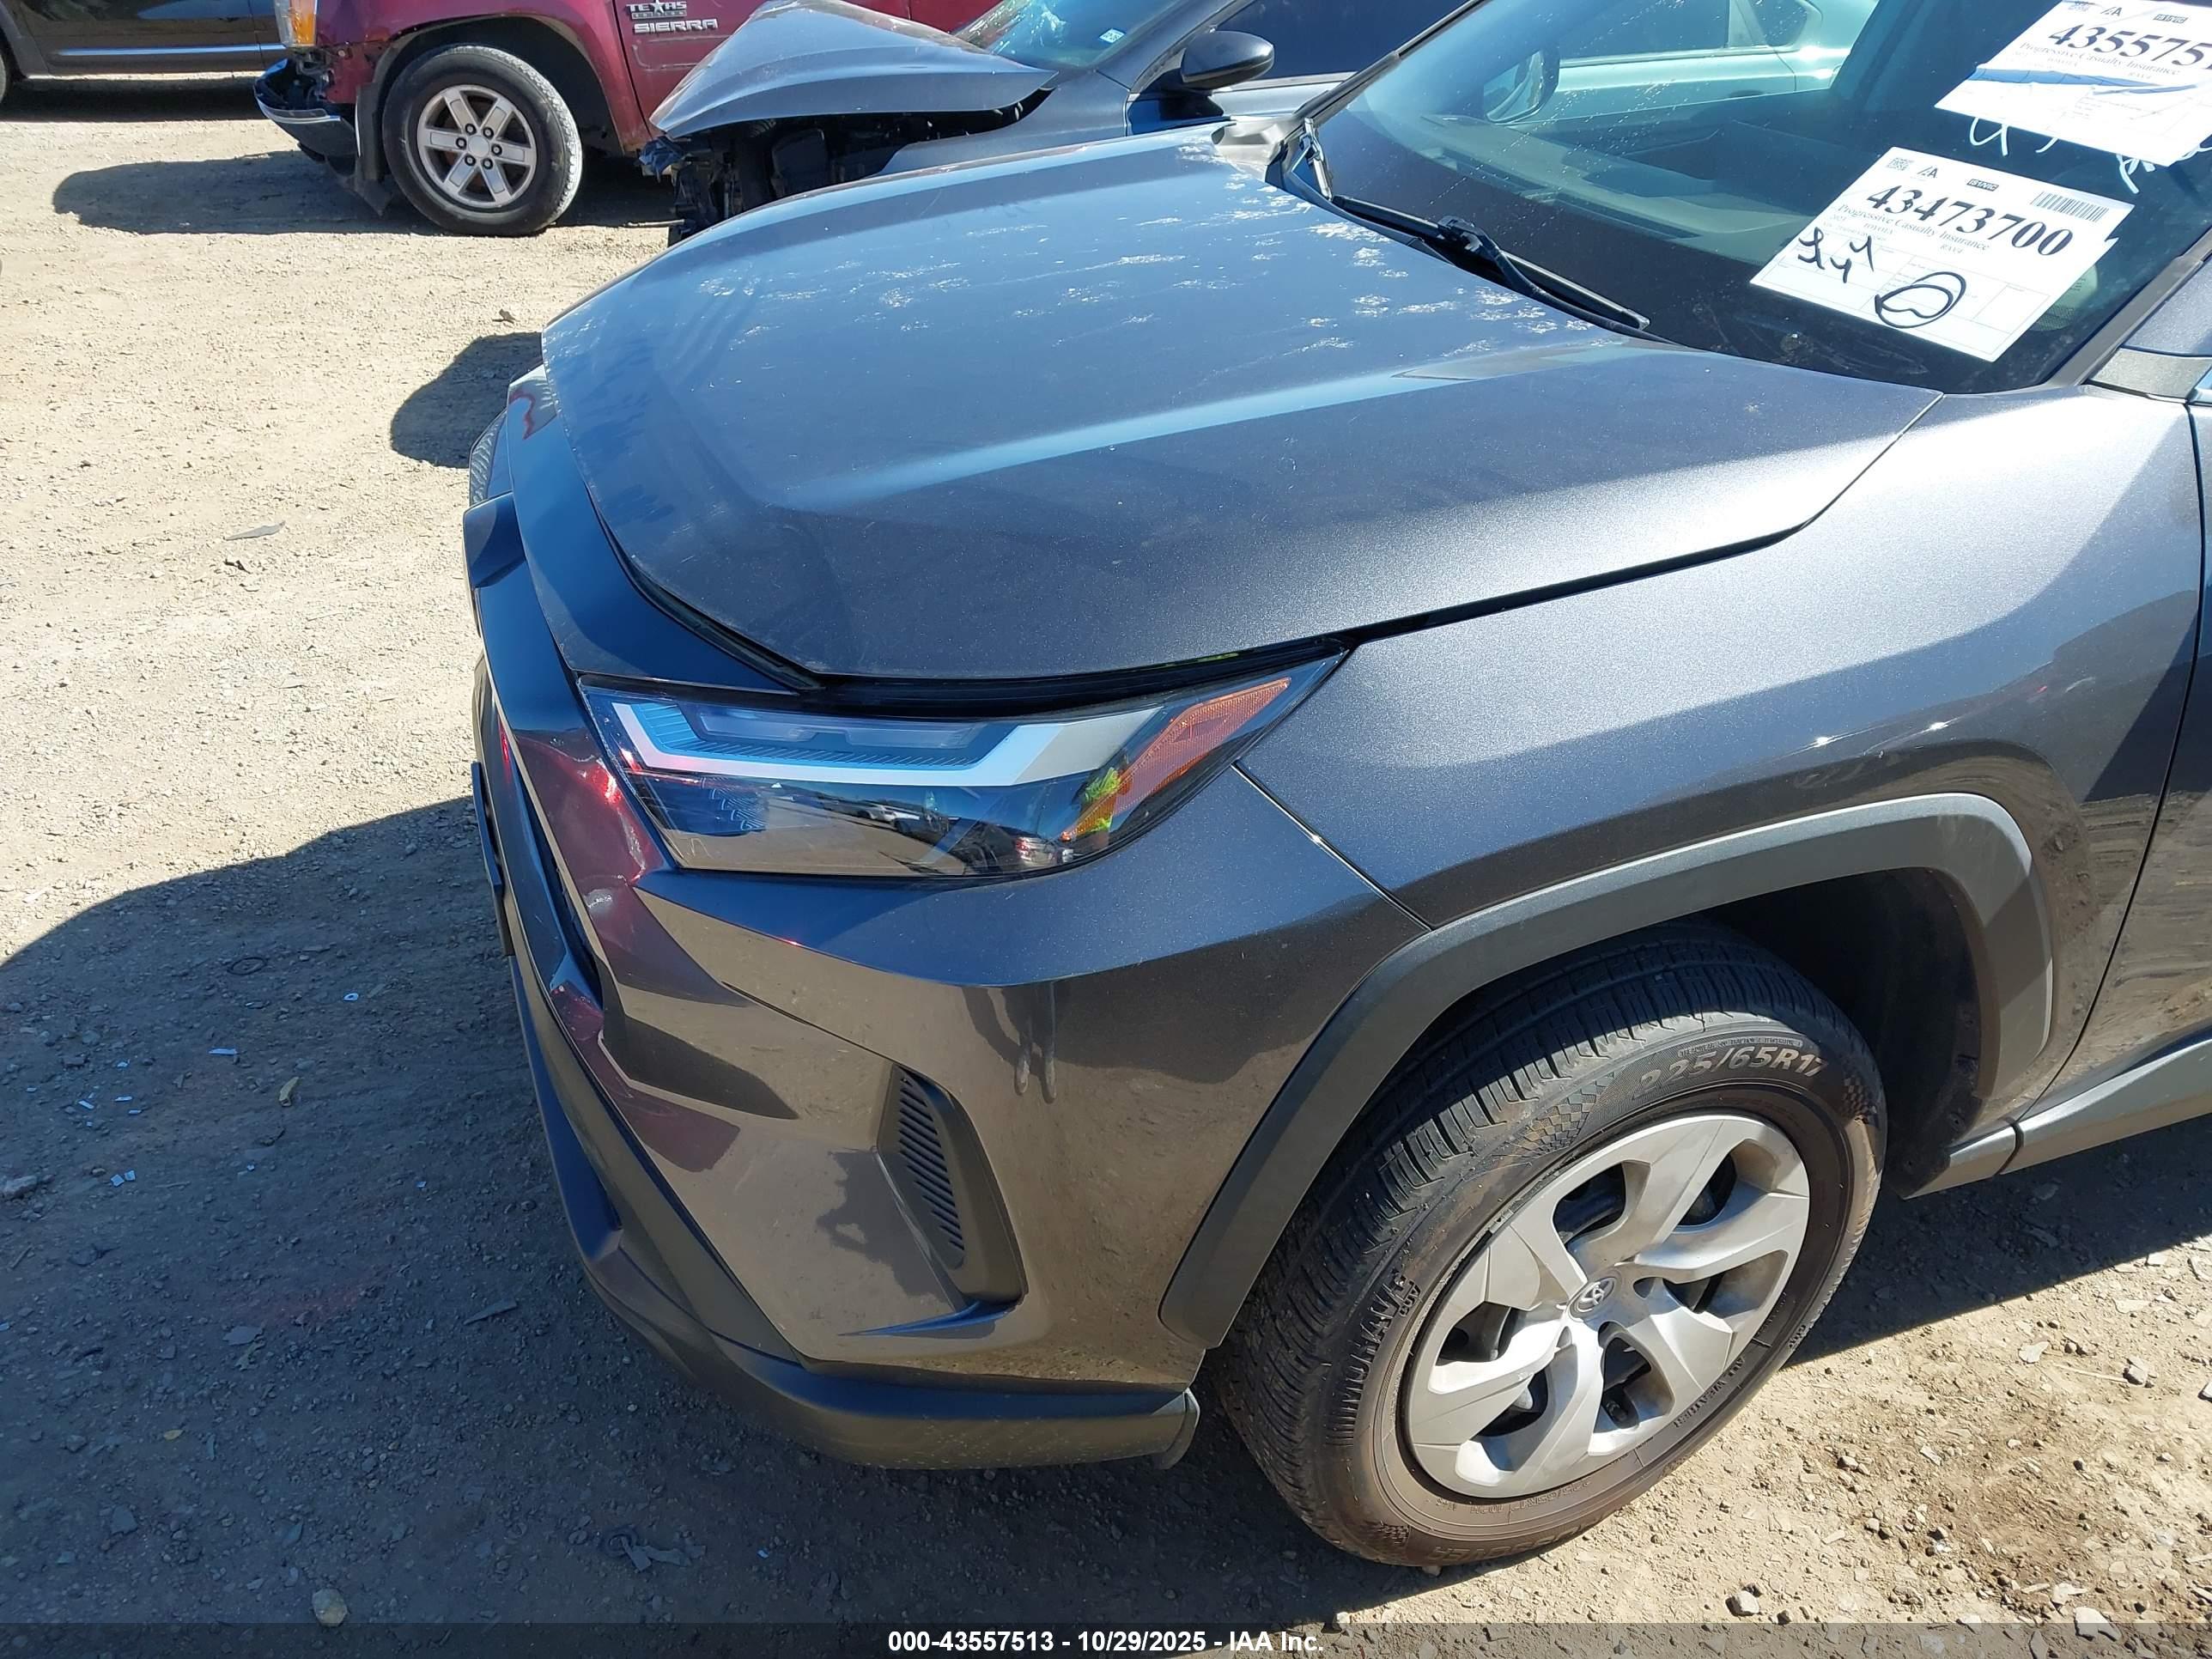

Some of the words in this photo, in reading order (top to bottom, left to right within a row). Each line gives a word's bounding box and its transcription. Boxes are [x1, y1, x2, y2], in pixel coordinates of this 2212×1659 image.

[634, 18, 719, 33] SIERRA
[2048, 24, 2212, 70] 435575
[2079, 51, 2124, 68] Casualty
[2126, 60, 2181, 76] Insurance
[1838, 204, 1894, 224] Progressive
[1895, 219, 1936, 237] Casualty
[1939, 230, 1990, 251] Insurance
[1867, 185, 2074, 256] 43473700
